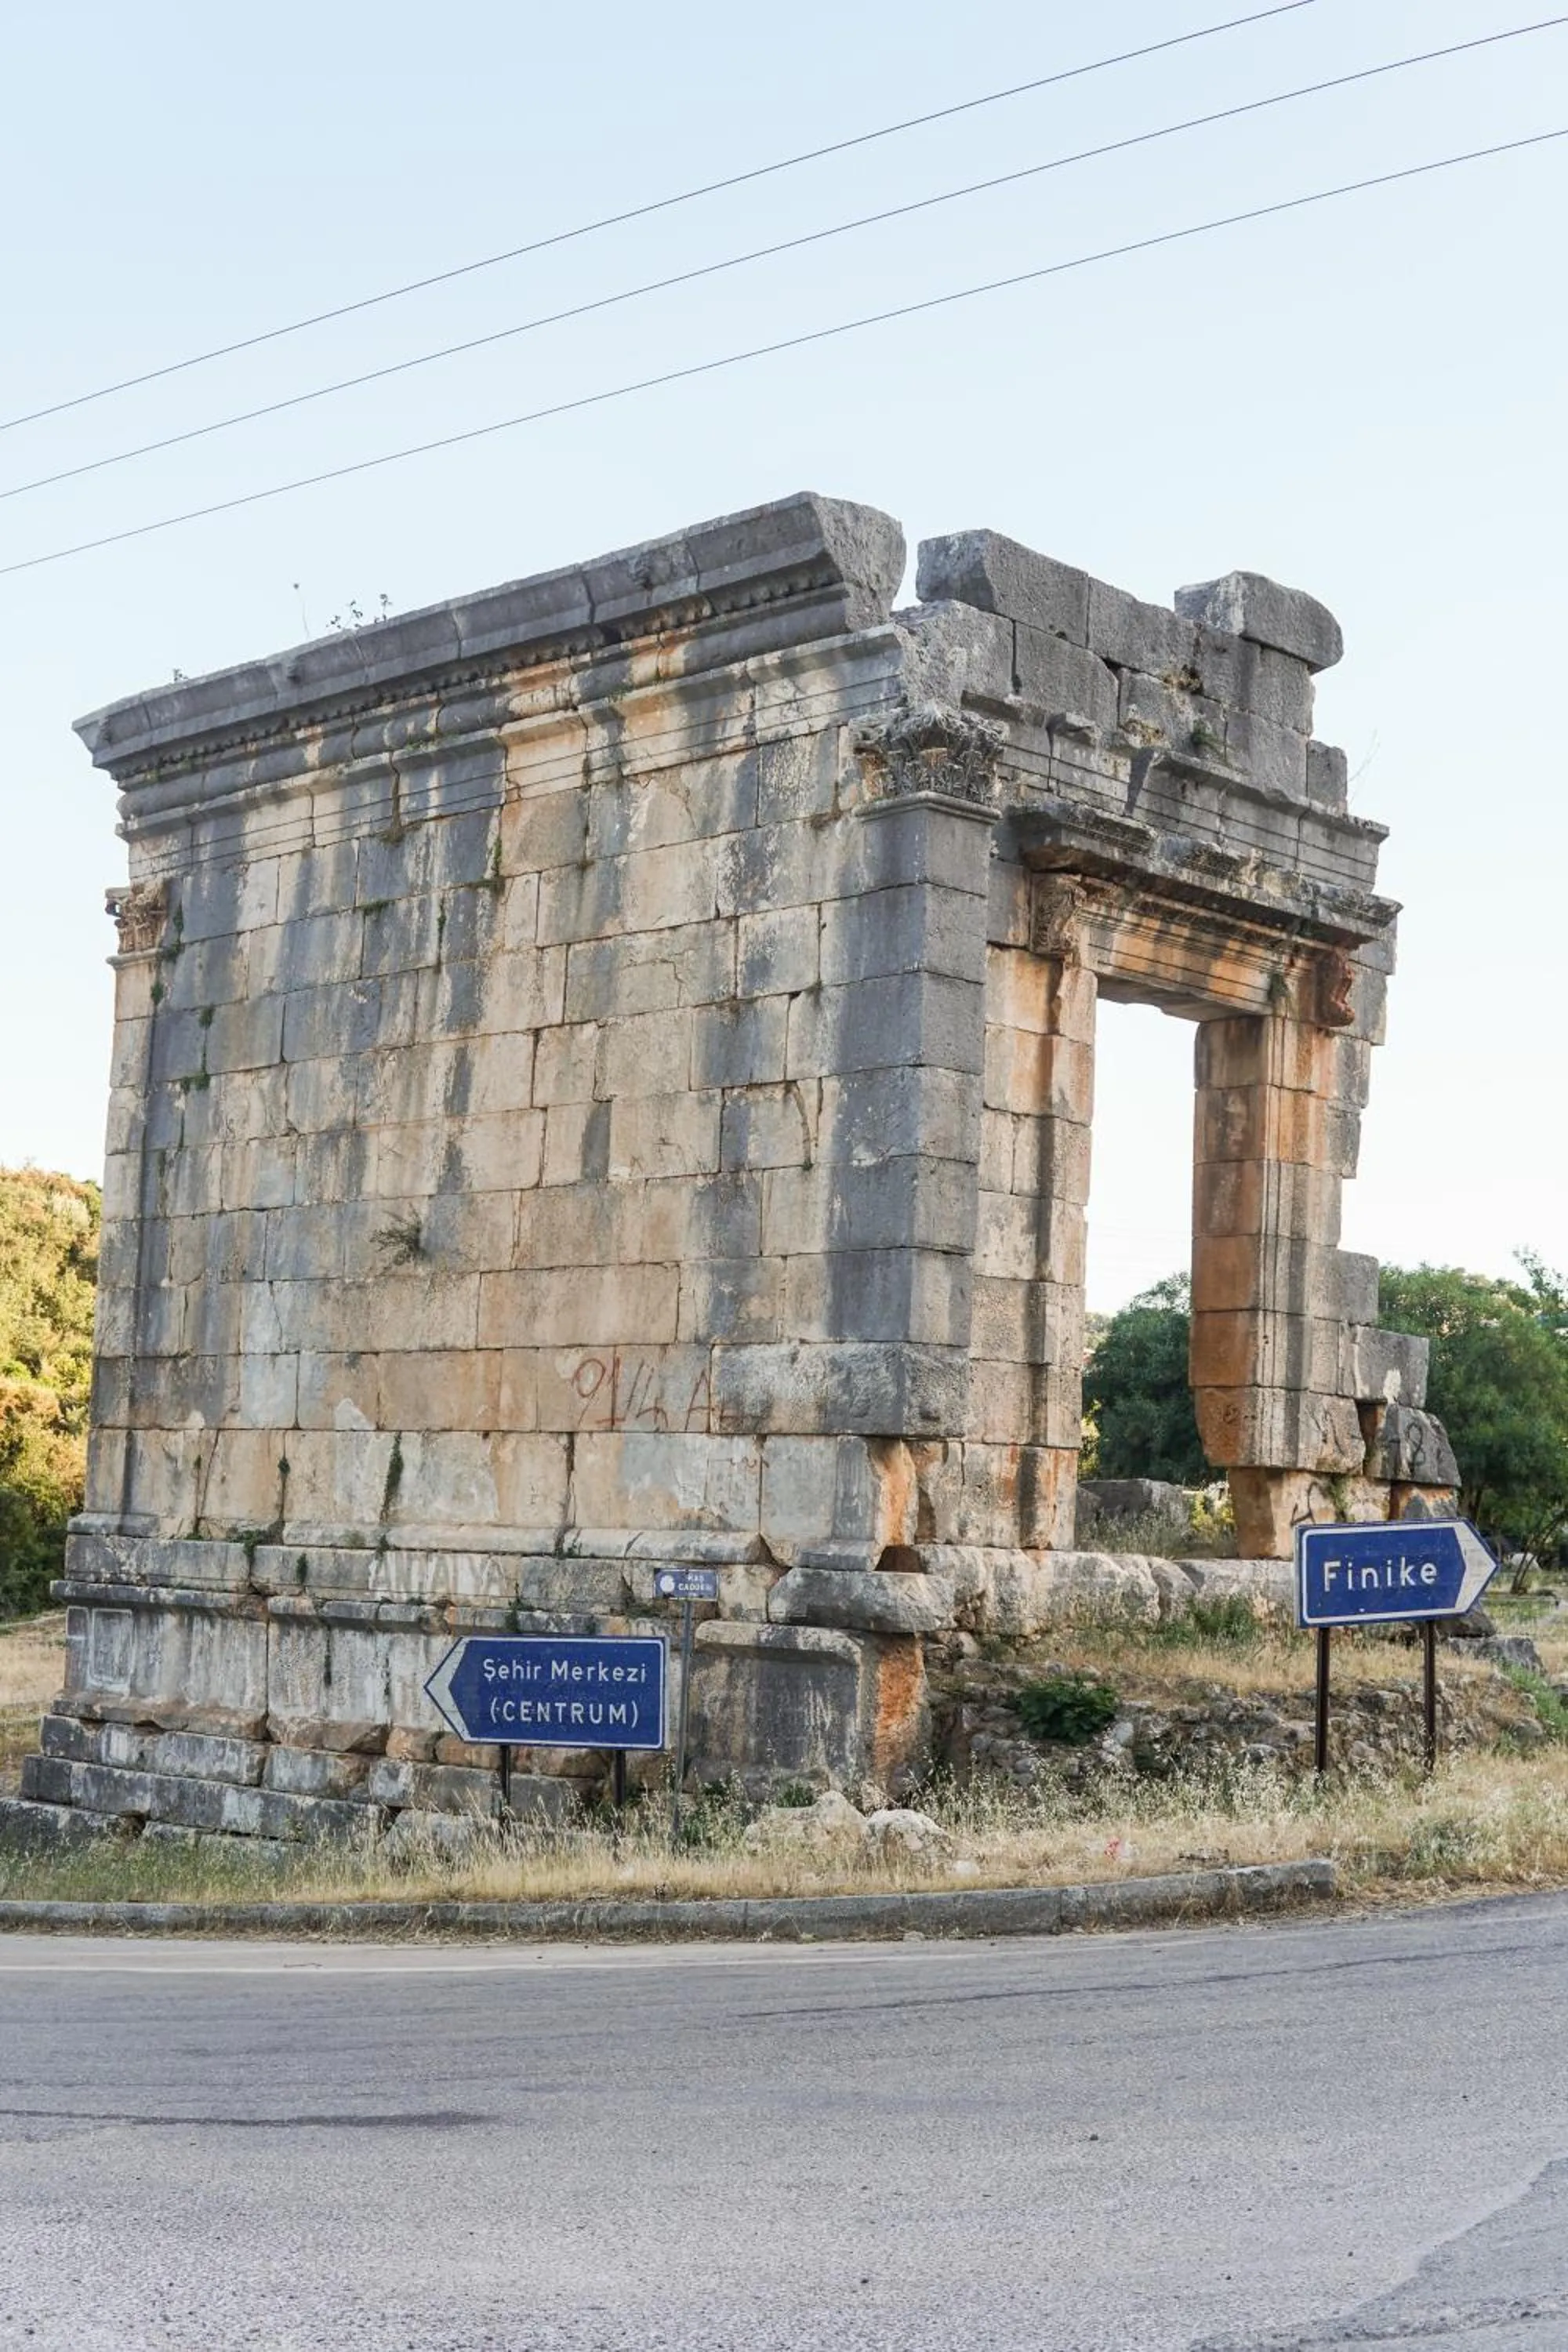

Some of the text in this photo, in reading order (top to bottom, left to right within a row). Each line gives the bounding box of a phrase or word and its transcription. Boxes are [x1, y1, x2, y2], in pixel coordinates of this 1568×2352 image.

[1323, 1556, 1438, 1592] Finike
[482, 1658, 646, 1682] Şehir Merkezi
[490, 1697, 639, 1728] (CENTRUM)
